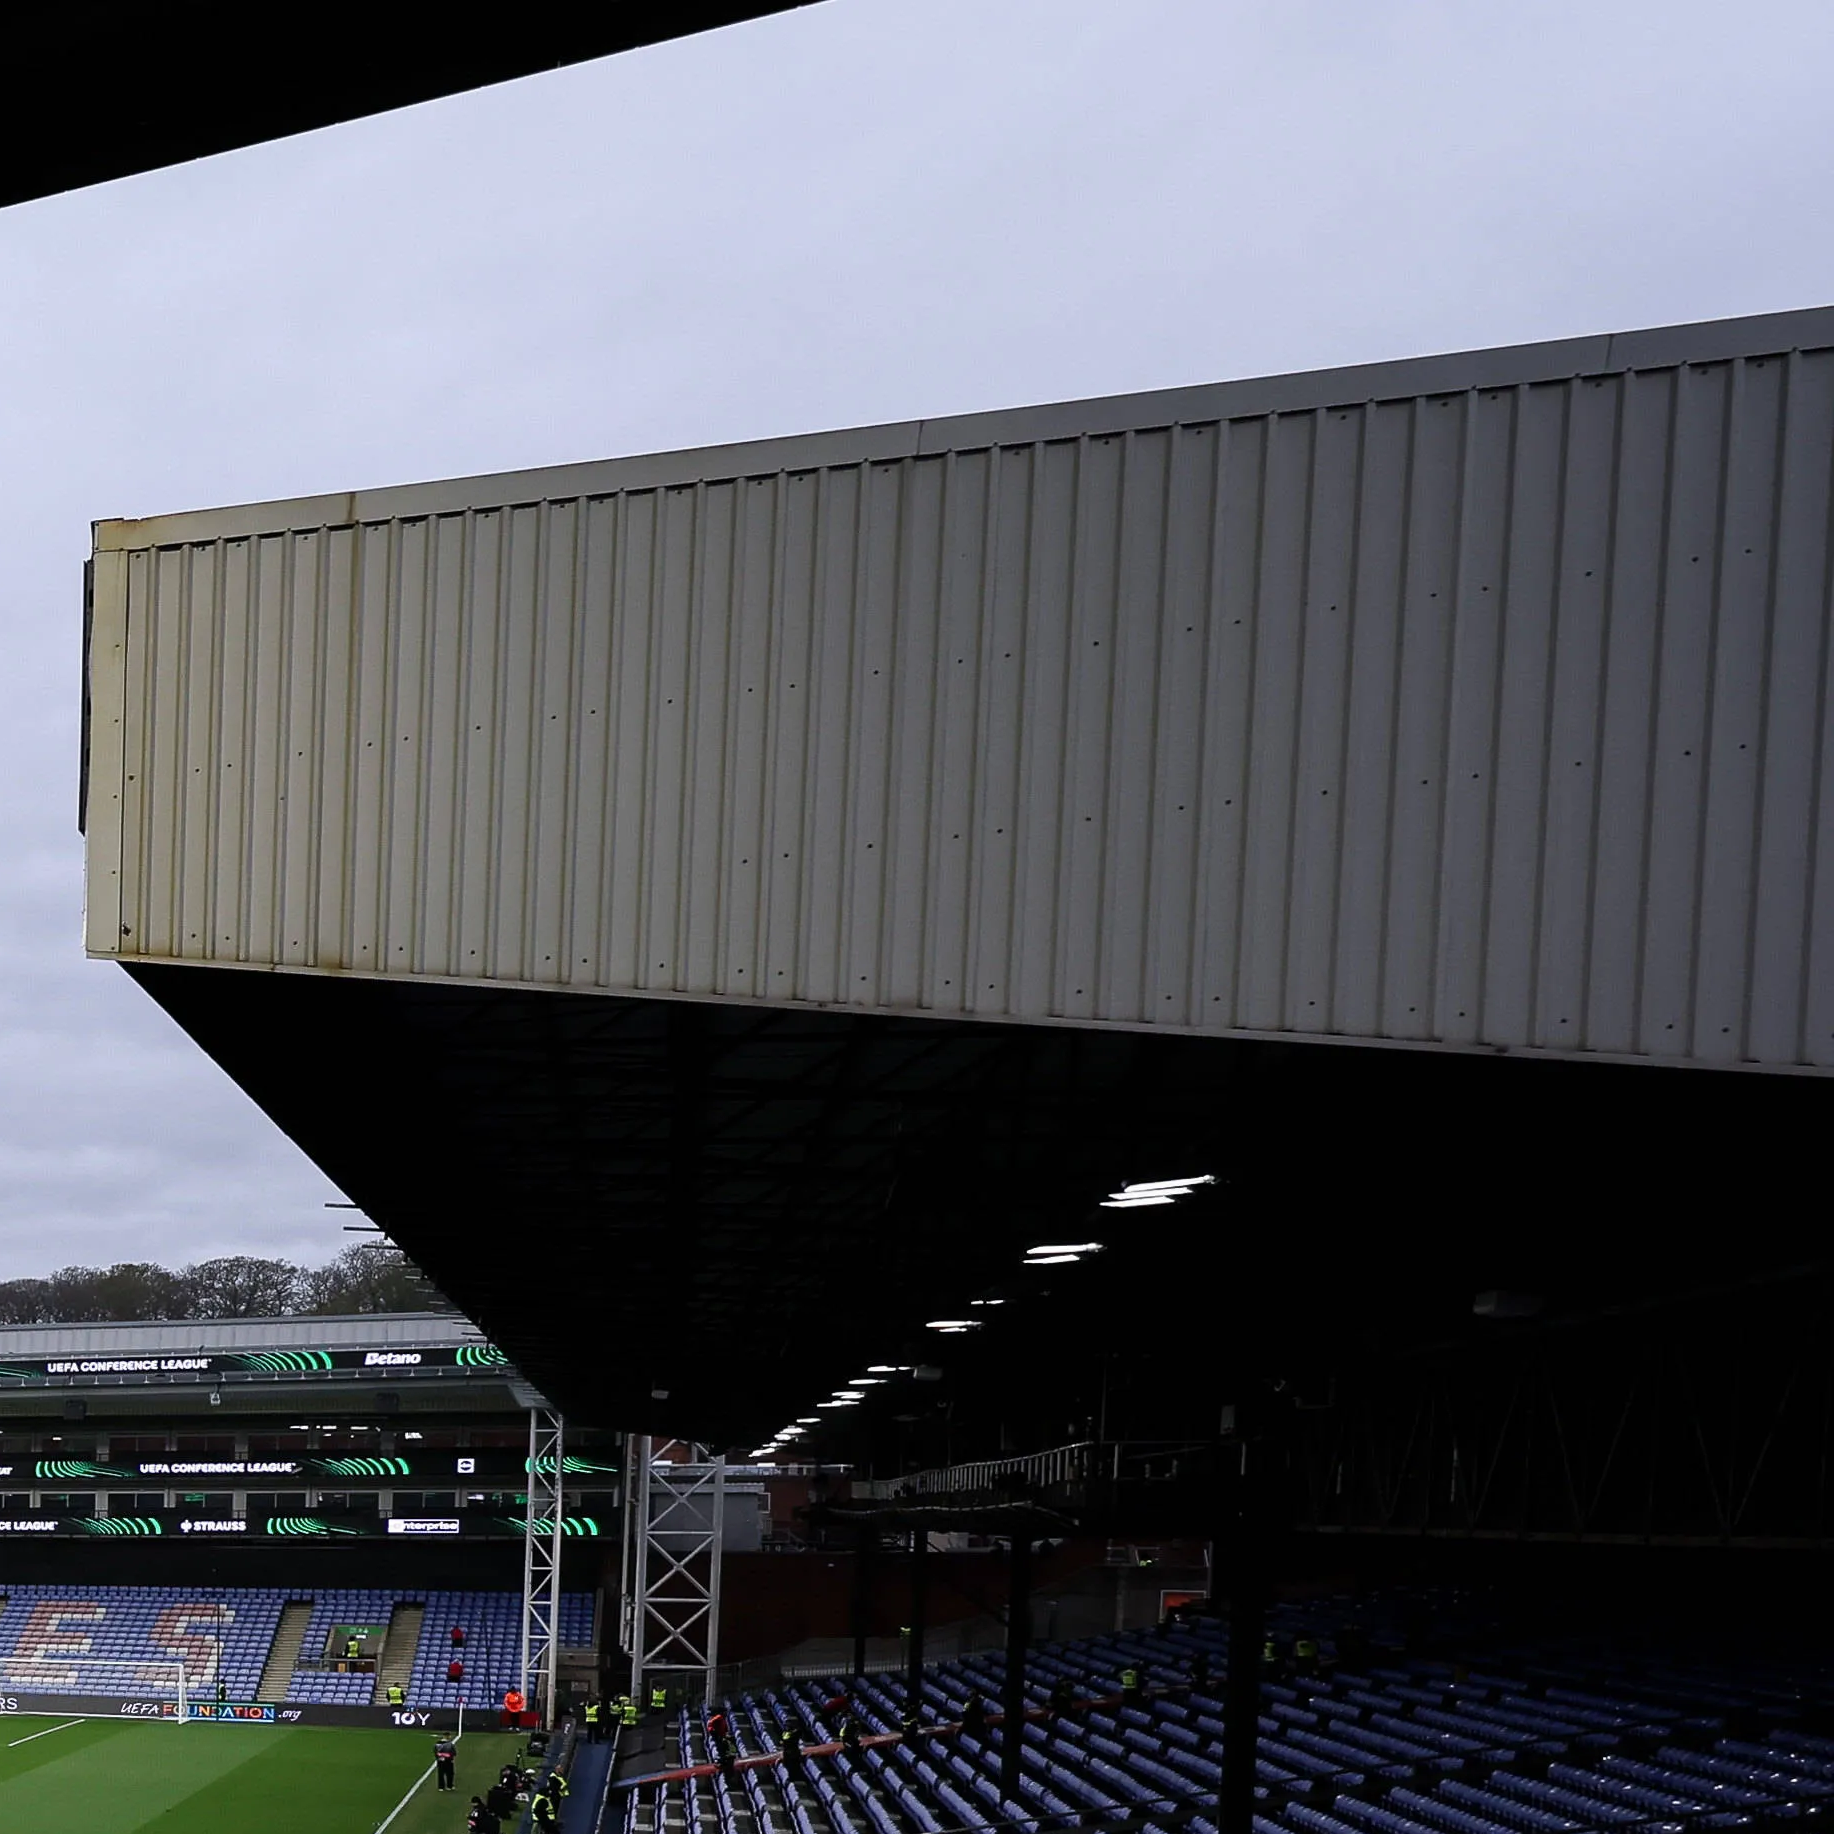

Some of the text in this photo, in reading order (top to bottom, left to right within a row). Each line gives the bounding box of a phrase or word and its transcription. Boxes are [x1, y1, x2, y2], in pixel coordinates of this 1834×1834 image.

[364, 1352, 422, 1365] Betano
[47, 1359, 208, 1373] UEFA CONFERENCE LEAGUE
[140, 1463, 292, 1473] UEFA CONFERENCE LEAGUE
[13, 1521, 55, 1530] LEAGUE
[193, 1520, 247, 1531] STRAUSS
[121, 1703, 302, 1721] UEFA FOUNDATION .org
